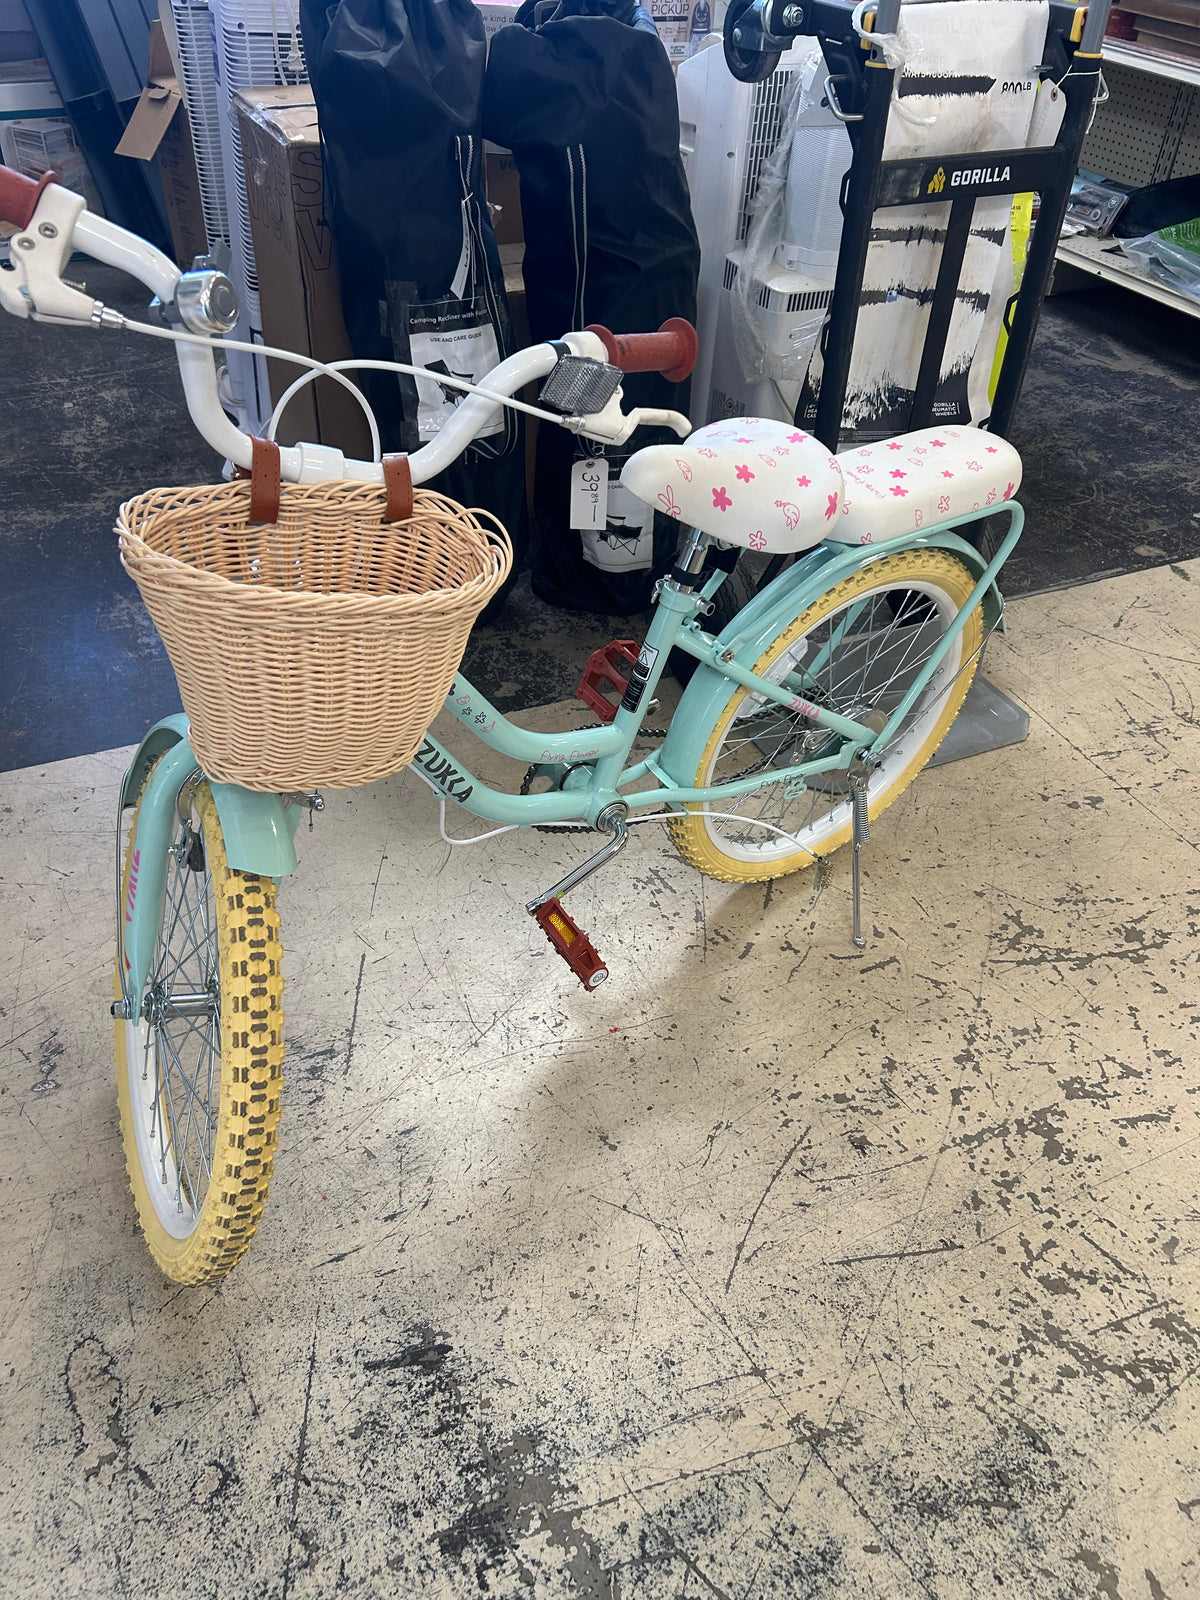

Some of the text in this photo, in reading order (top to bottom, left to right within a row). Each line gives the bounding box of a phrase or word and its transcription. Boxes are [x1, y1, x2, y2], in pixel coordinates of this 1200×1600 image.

[651, 4, 689, 15] PICKUP
[490, 14, 507, 23] kind
[950, 166, 1011, 187] GORILLA
[410, 316, 437, 325] Camping
[438, 313, 461, 322] Recliner
[461, 311, 475, 319] with
[540, 749, 600, 762] Flying Flower
